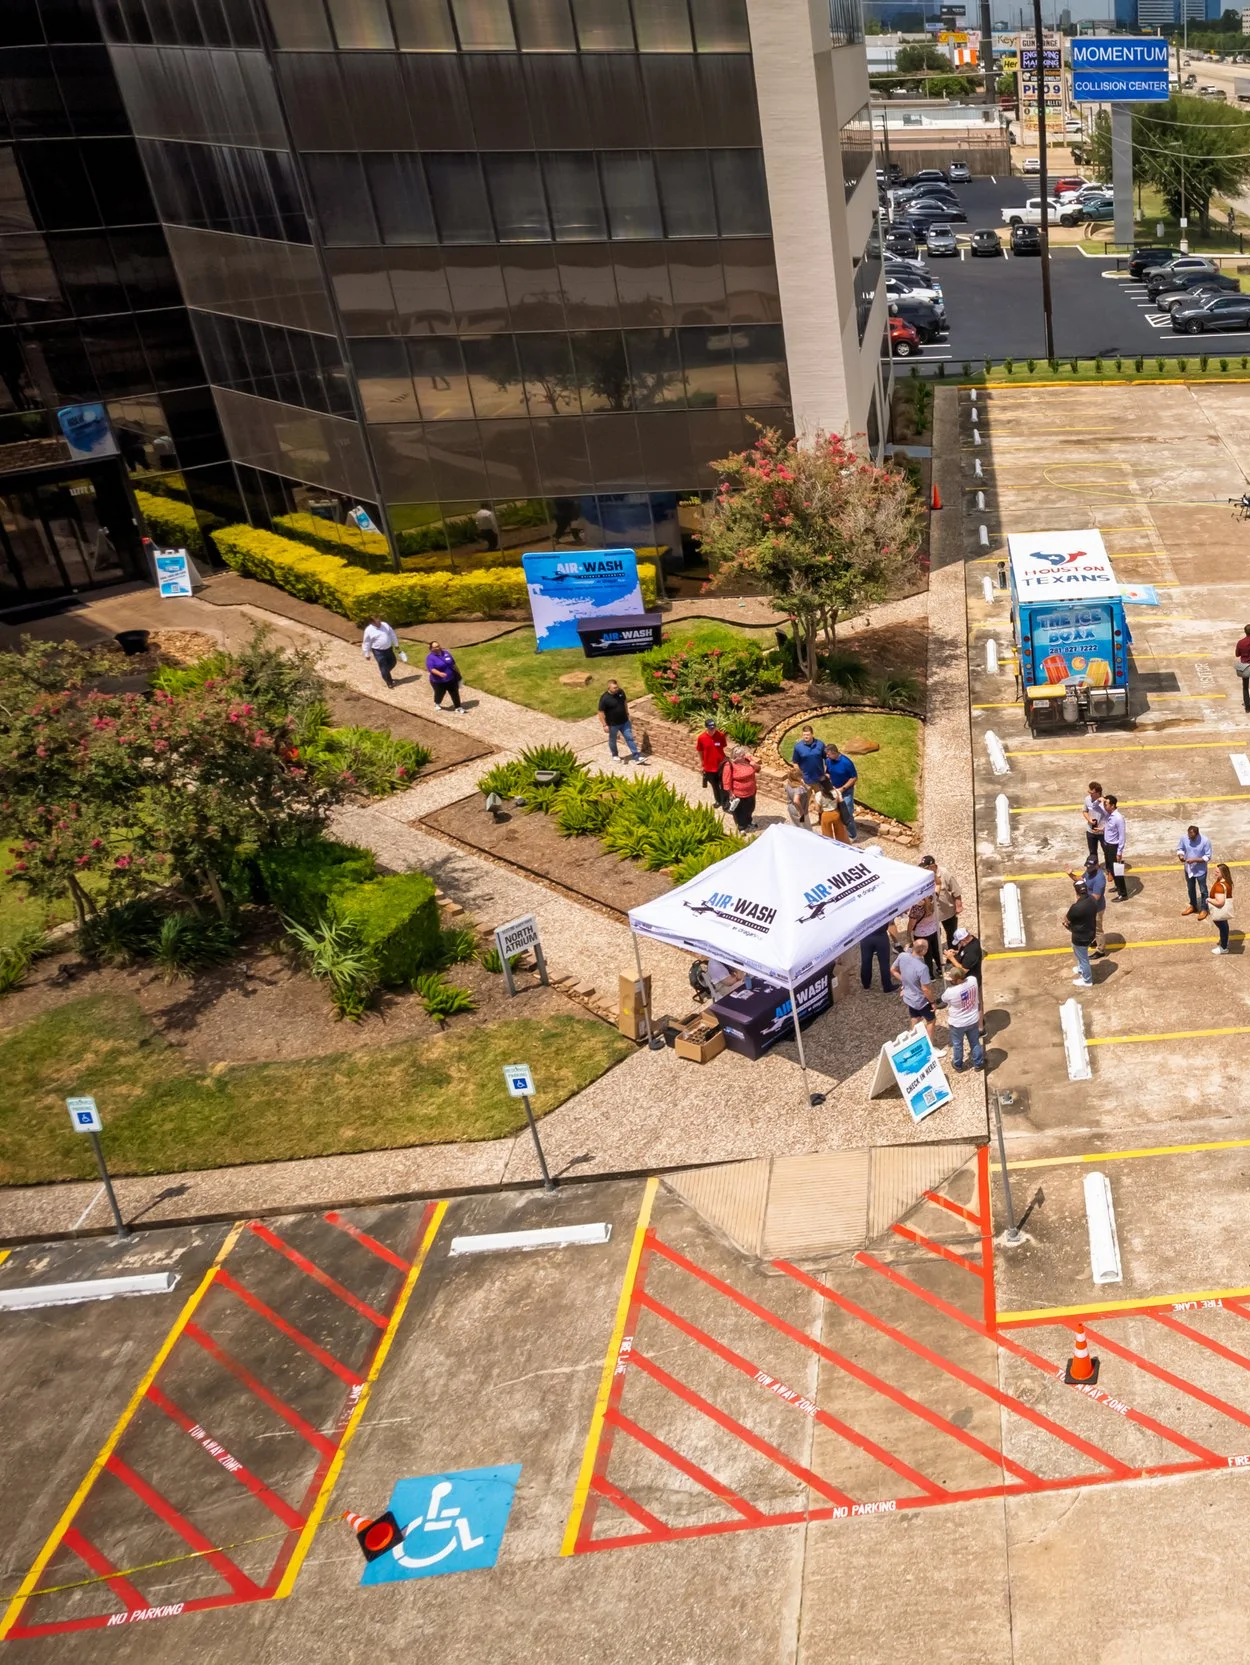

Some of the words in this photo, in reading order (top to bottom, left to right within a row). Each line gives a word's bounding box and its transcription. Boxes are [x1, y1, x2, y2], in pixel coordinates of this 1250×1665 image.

[1074, 47, 1168, 61] MOMENTUM
[1053, 84, 1060, 94] 9
[1075, 82, 1126, 91] COLLISION
[1128, 82, 1167, 91] CENTER
[1022, 574, 1110, 586] TEXANS
[1024, 566, 1105, 576] HOUSTON
[1037, 613, 1071, 631] THE
[1074, 608, 1102, 627] ICE
[504, 925, 534, 945] NORTH
[506, 932, 538, 954] ATRIUM
[906, 1077, 920, 1094] CHECK
[920, 1074, 926, 1082] IN
[926, 1060, 937, 1076] HERE!
[1172, 1301, 1198, 1312] LANE
[1200, 1299, 1224, 1308] FIRE
[619, 1336, 634, 1353] FIRE
[614, 1355, 631, 1376] LANE
[345, 1383, 364, 1408] LANE
[754, 1370, 773, 1384] TOW
[771, 1382, 798, 1402] AWAY
[793, 1397, 820, 1417] ZONE
[1056, 1370, 1067, 1383] TO
[1075, 1383, 1103, 1400] AWAY
[1102, 1396, 1130, 1415] ZONE
[188, 1424, 206, 1440] TOW
[202, 1437, 226, 1457] AWAY
[218, 1454, 243, 1473] ZONE
[1227, 1455, 1250, 1468] FIRE
[832, 1506, 848, 1518] NO
[850, 1500, 897, 1517] PARKING
[106, 1612, 128, 1627] NO
[130, 1602, 184, 1623] PARKING
